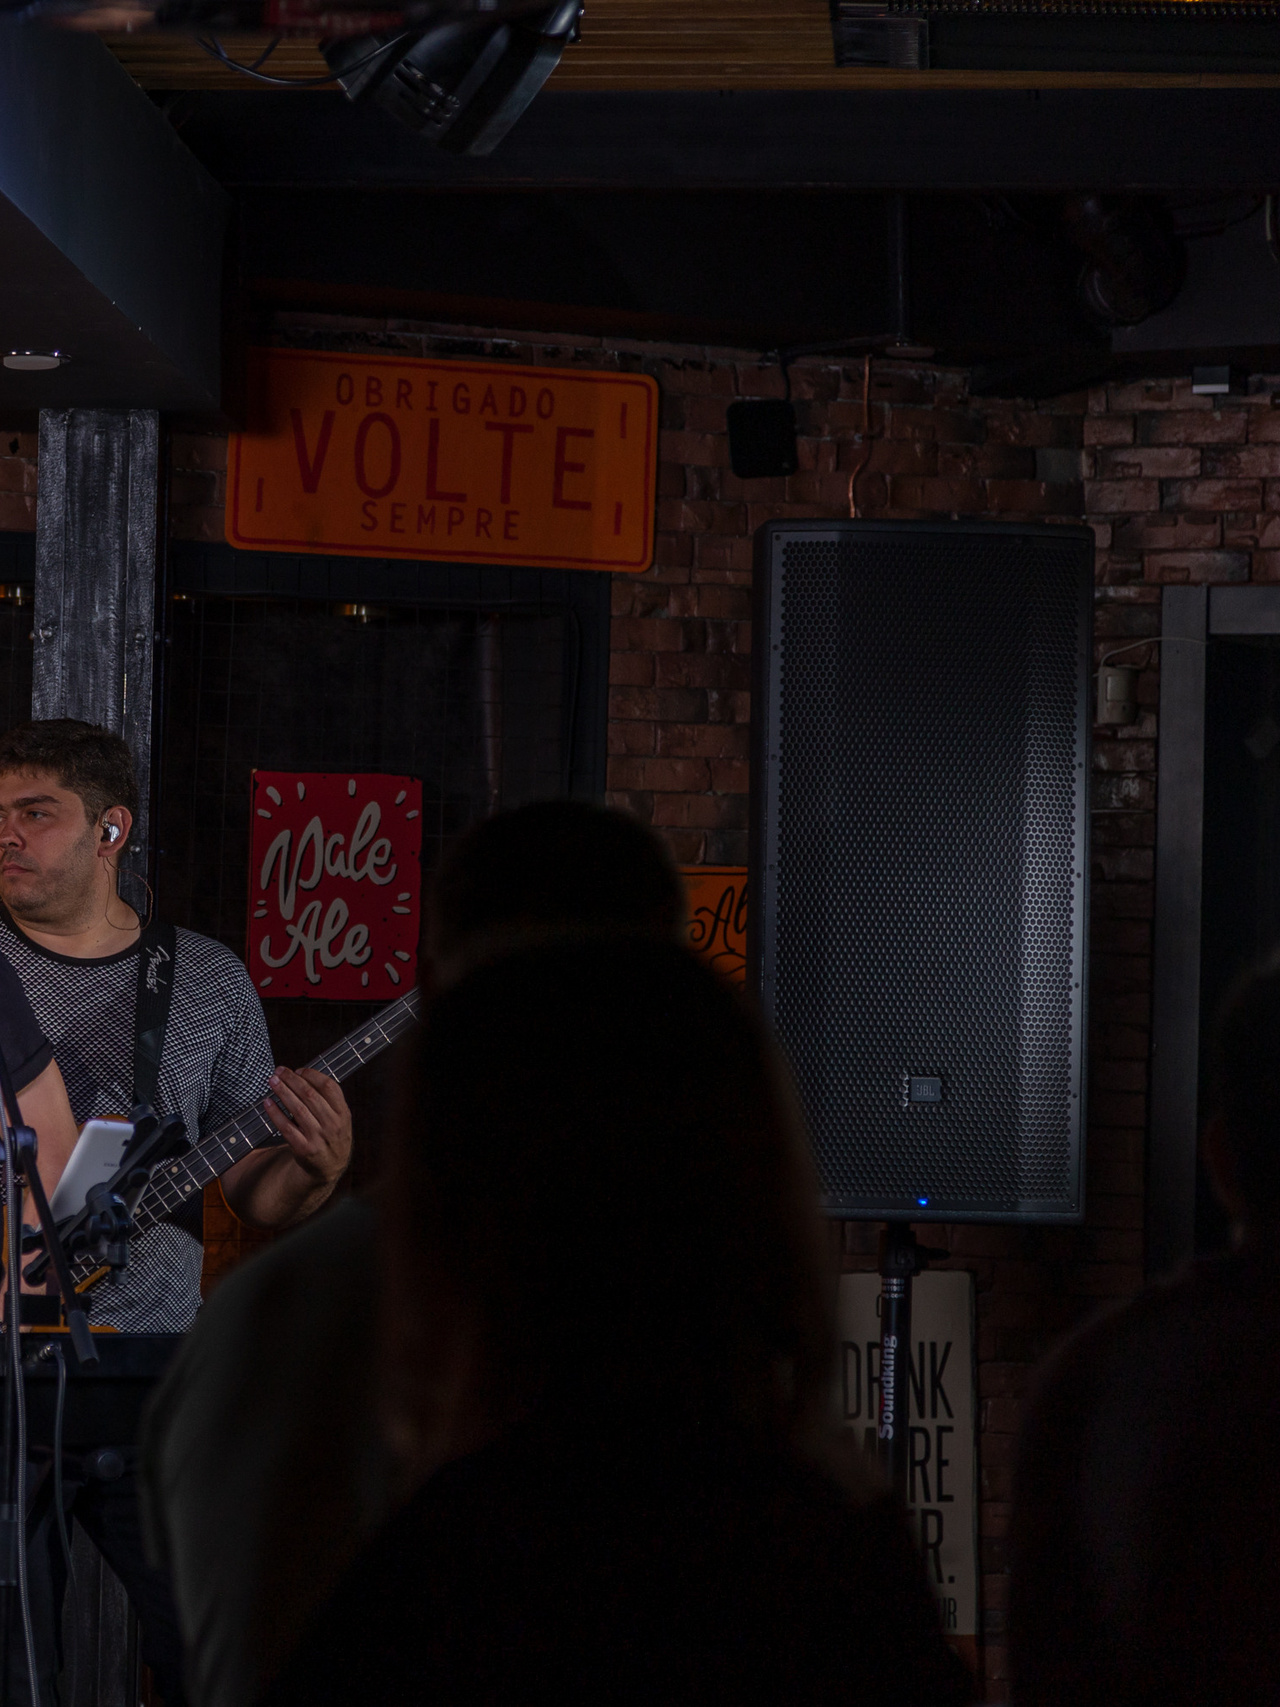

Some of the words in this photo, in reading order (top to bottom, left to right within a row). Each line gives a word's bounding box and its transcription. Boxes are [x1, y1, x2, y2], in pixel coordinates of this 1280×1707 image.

[336, 372, 555, 420] OBRIGADO
[290, 407, 595, 512] VOLTE
[360, 502, 520, 540] SEMPRE
[260, 800, 398, 921] Pale
[260, 897, 372, 984] Ale
[916, 1084, 936, 1097] JBL
